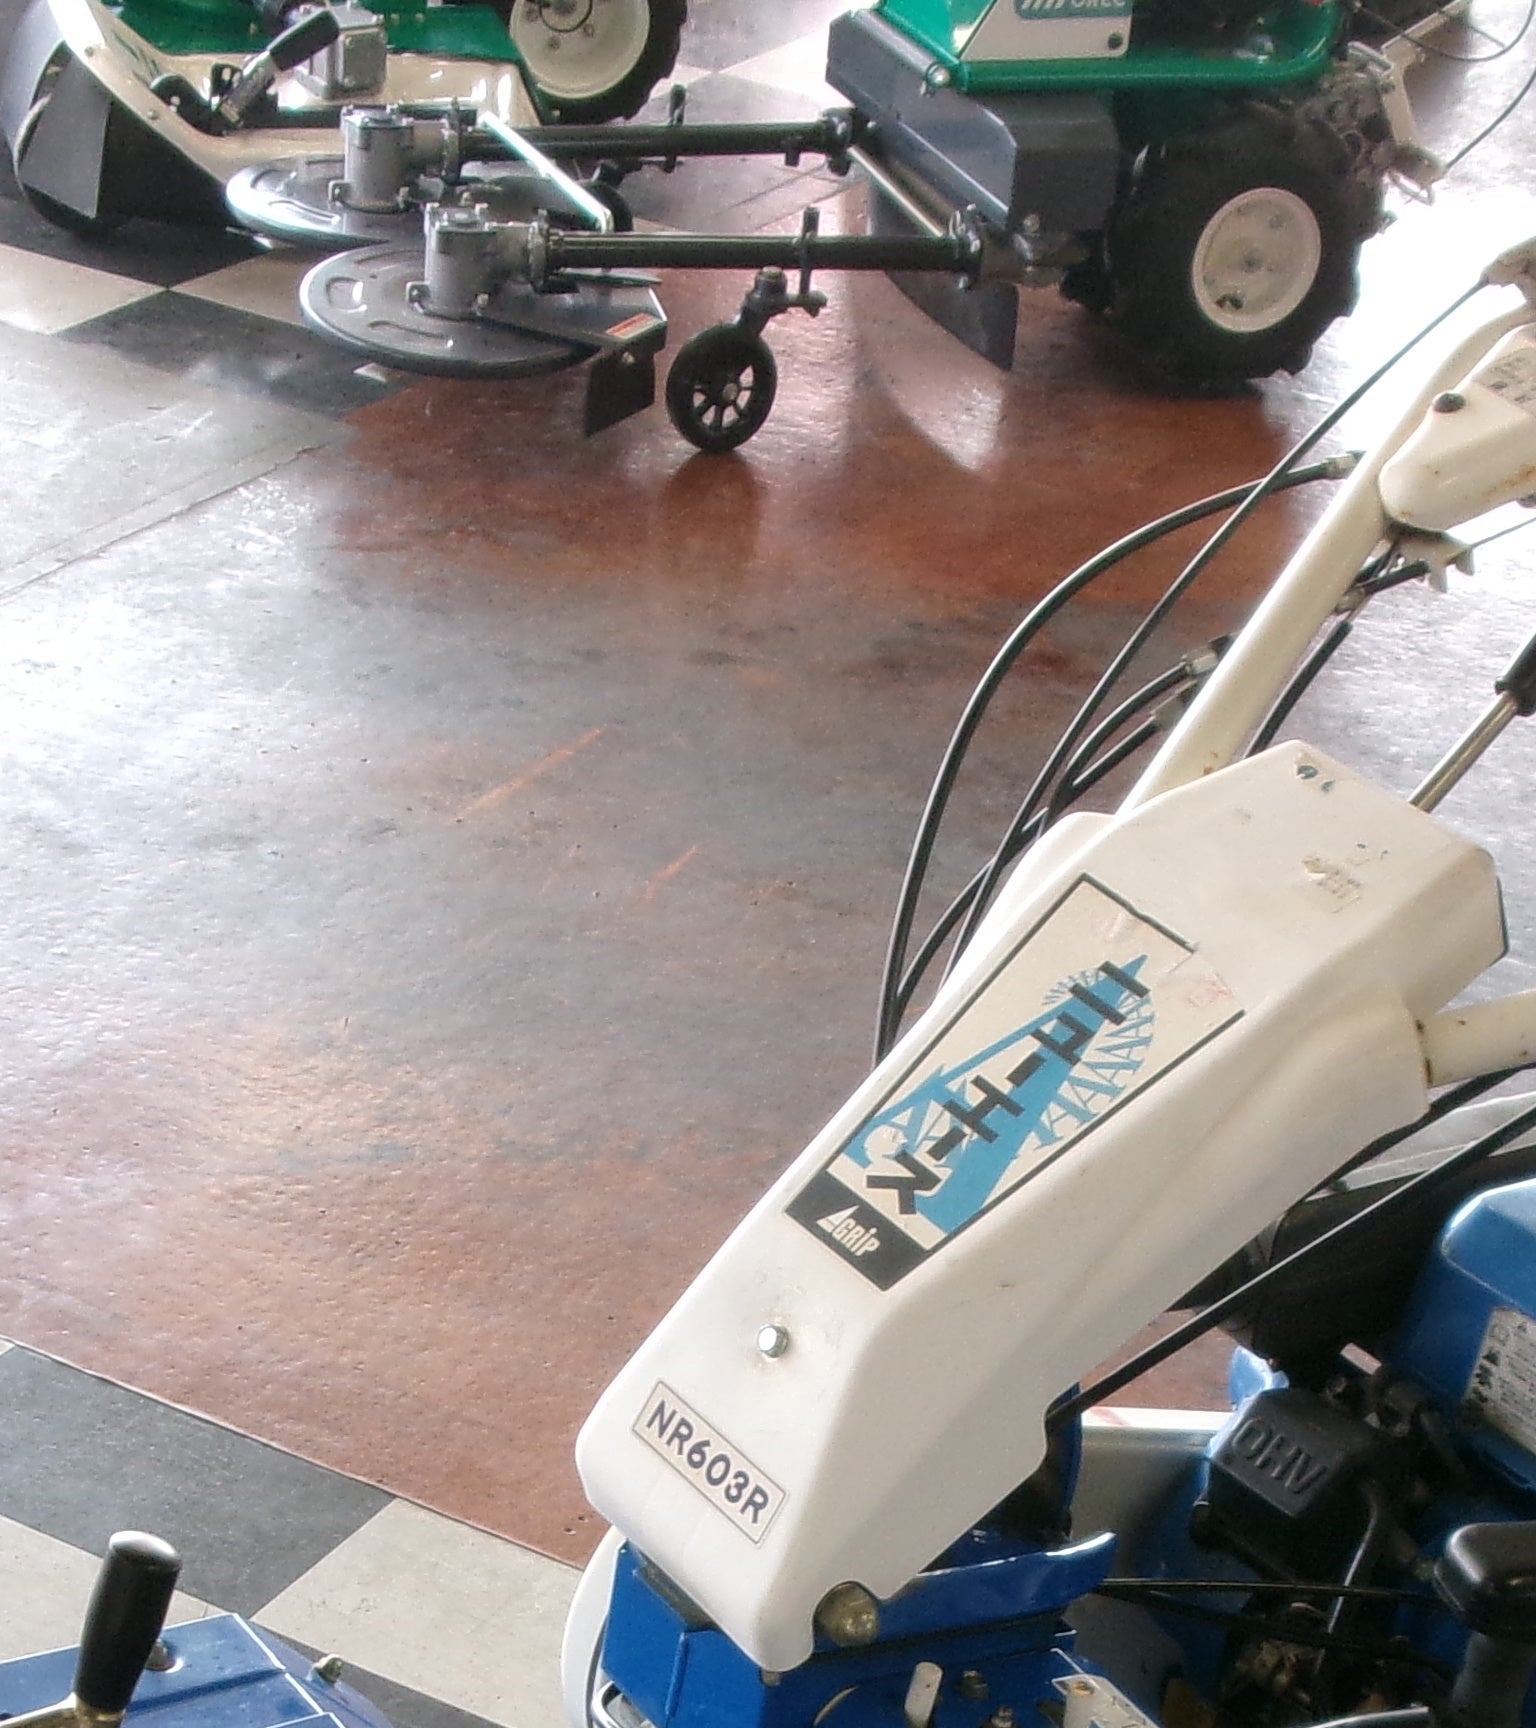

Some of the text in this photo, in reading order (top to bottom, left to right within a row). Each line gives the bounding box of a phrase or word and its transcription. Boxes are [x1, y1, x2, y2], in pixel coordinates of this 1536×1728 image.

[866, 961, 1151, 1215] ニューエース
[646, 1399, 769, 1524] NR603R
[1232, 1417, 1327, 1494] OHV
